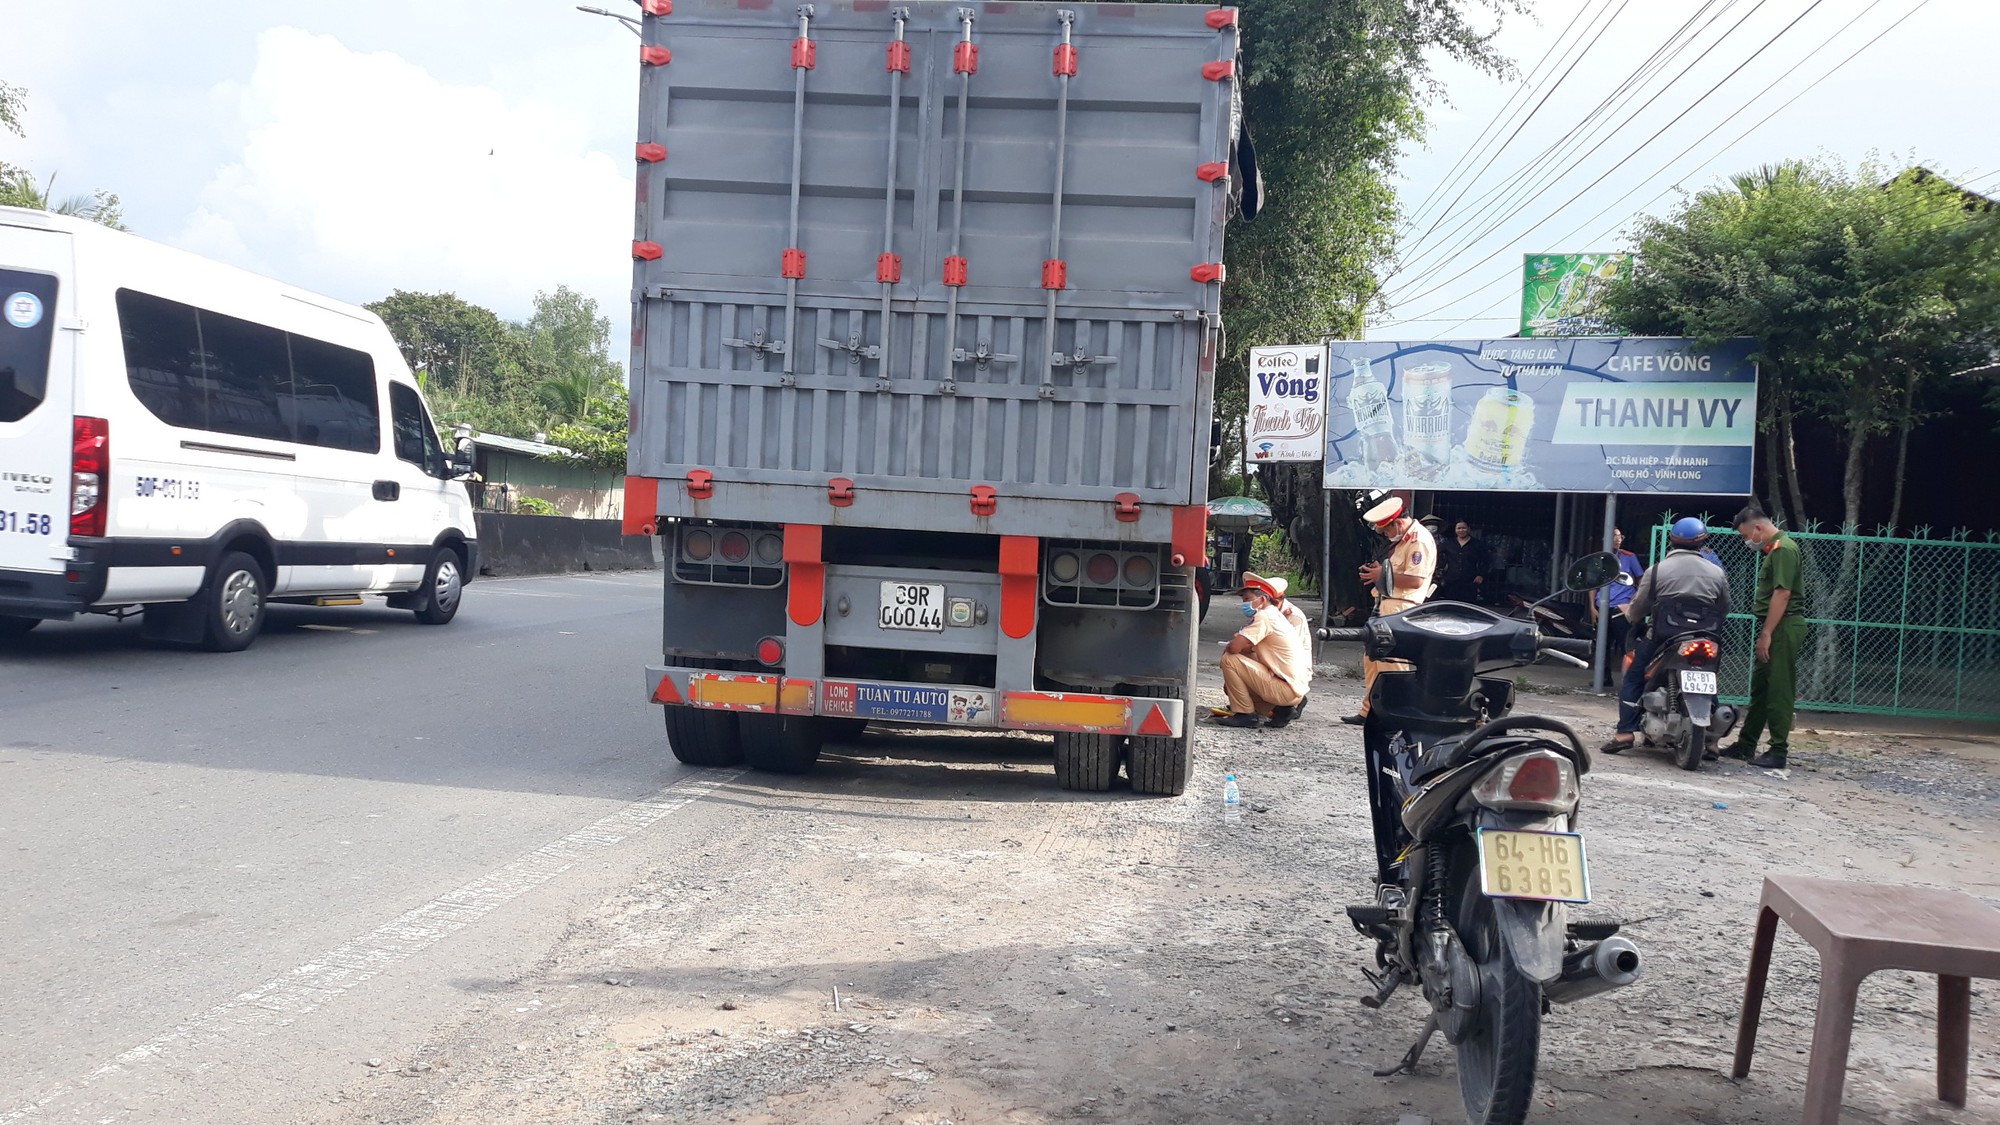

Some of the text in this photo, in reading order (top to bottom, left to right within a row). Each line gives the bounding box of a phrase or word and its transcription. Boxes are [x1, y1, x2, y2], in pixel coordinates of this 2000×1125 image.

[1607, 352, 1711, 372] CAFE VÕNG
[1541, 365, 1563, 376] LAN
[1257, 372, 1319, 403] Võng
[1575, 398, 1742, 428] THANH VY
[1406, 414, 1449, 434] WARRIOR
[2, 472, 52, 484] IVECO
[1611, 469, 1636, 479] LONG
[1655, 468, 1676, 479] VĨNH
[1678, 470, 1701, 480] LONG
[829, 685, 849, 698] LONG
[1684, 682, 1714, 693] 494.79
[858, 687, 947, 706] TUAN TU AUTO
[824, 699, 854, 713] VEHICLE
[890, 707, 932, 718] 0977271788
[1497, 864, 1573, 897] 6385
